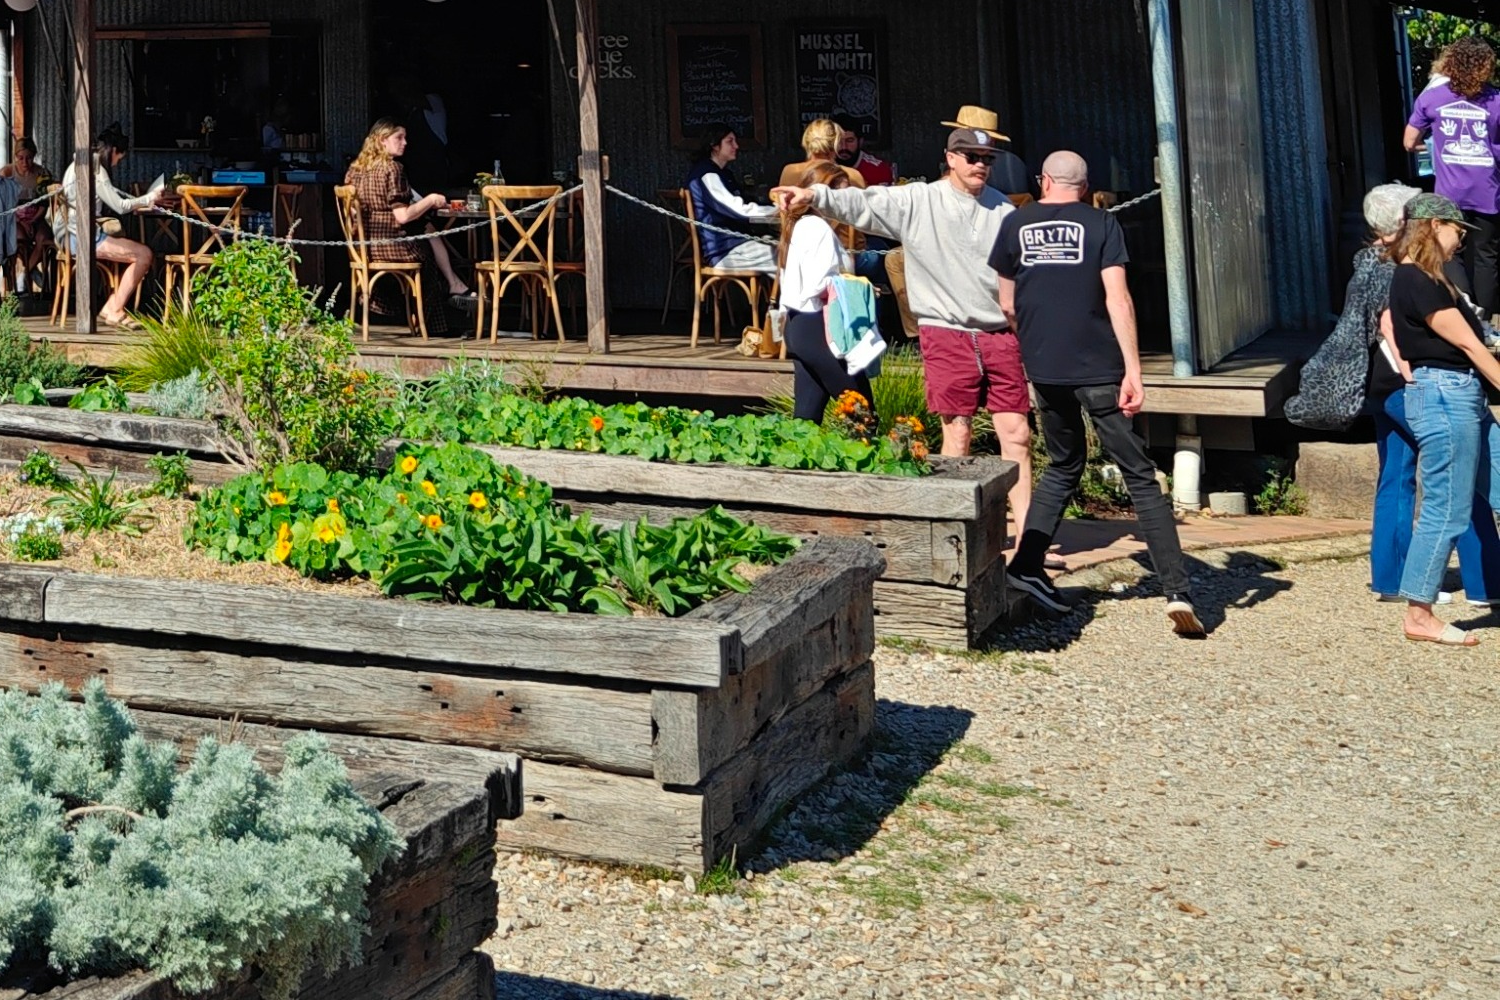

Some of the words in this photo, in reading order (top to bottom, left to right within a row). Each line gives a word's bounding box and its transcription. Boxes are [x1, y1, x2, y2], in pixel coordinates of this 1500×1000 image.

[597, 34, 629, 49] ree
[799, 33, 864, 50] MUSSEL
[598, 50, 623, 63] ue
[817, 52, 873, 71] NIGHT!
